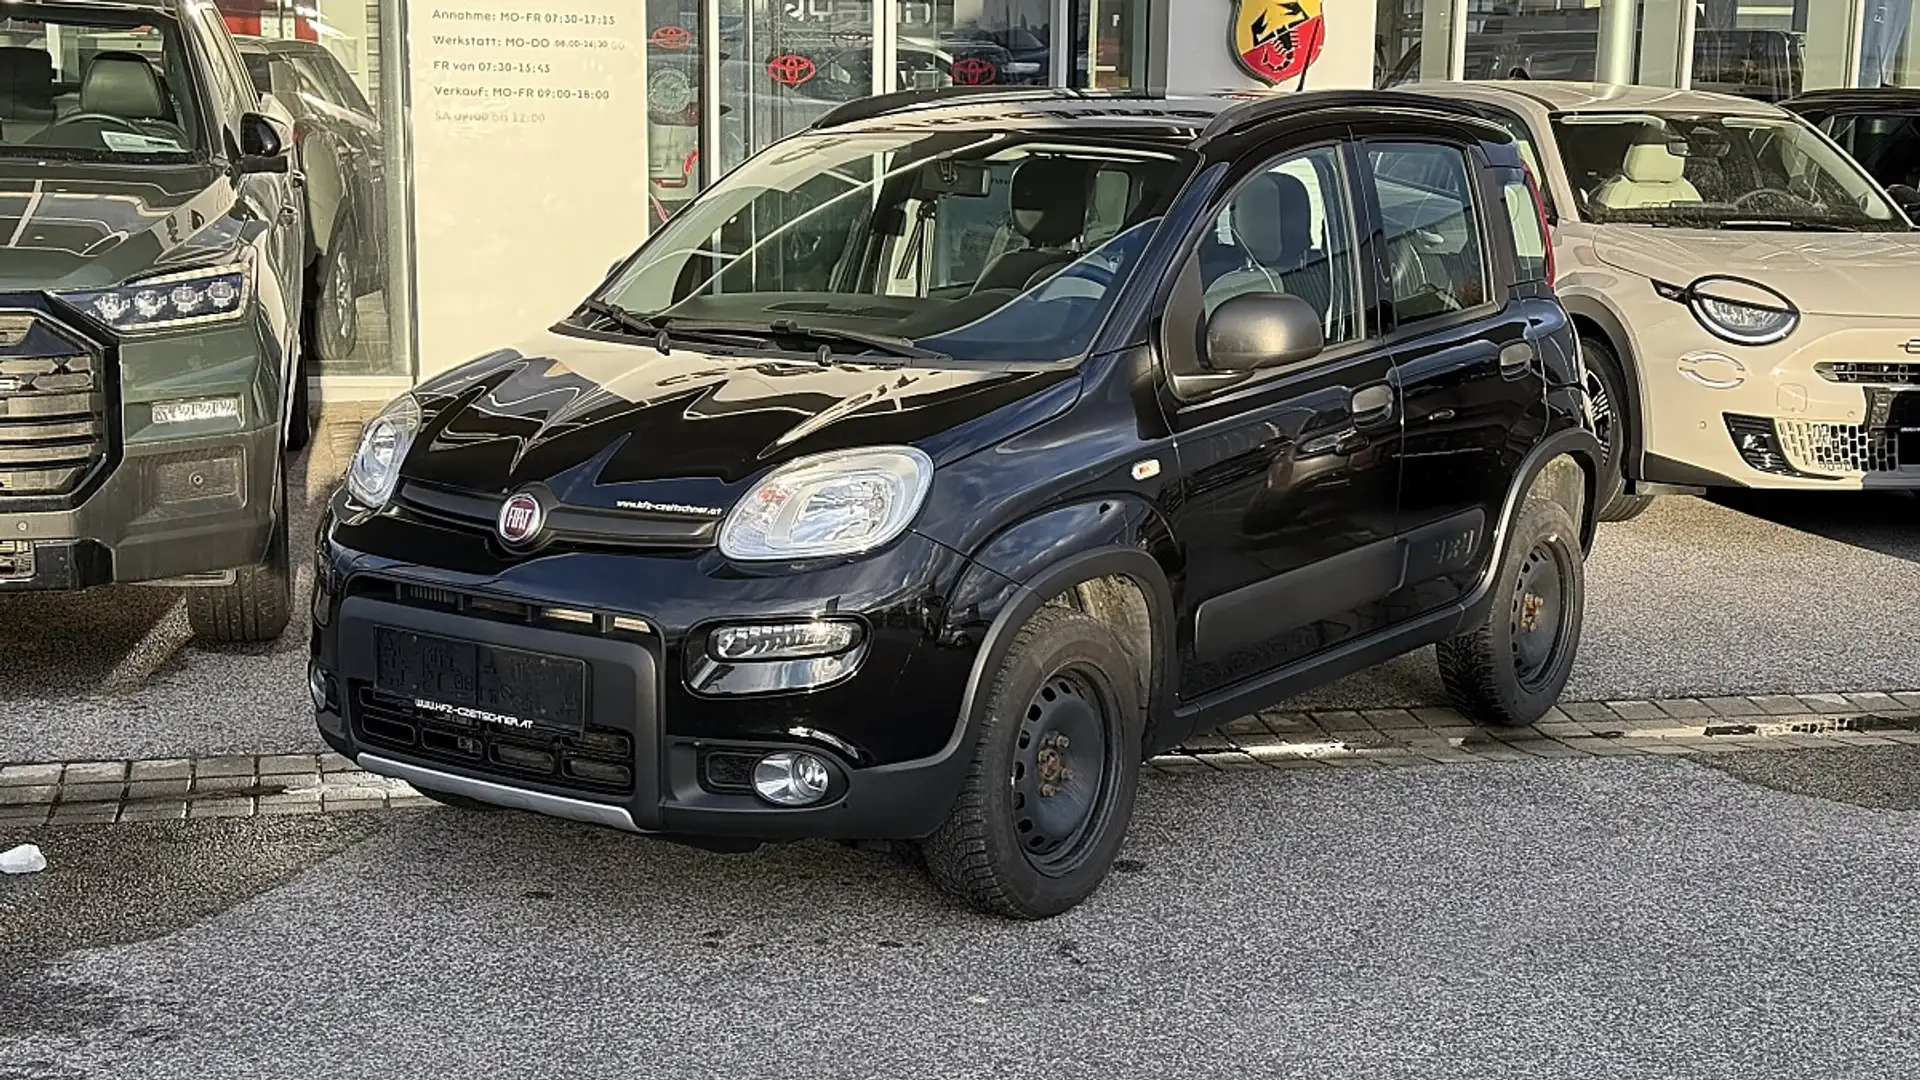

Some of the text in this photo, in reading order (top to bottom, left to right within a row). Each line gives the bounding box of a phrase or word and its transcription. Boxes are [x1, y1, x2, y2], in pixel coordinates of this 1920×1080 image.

[500, 12, 541, 22] MO-FR
[544, 13, 616, 25] 07:30-17:15
[432, 35, 502, 46] Werkstatt:
[505, 37, 550, 48] MO-DO
[433, 60, 551, 74] FR von 07:30-15:45
[434, 85, 610, 100] Verkauf: MO-FR 09:00-18:00
[505, 506, 533, 531] FIAT
